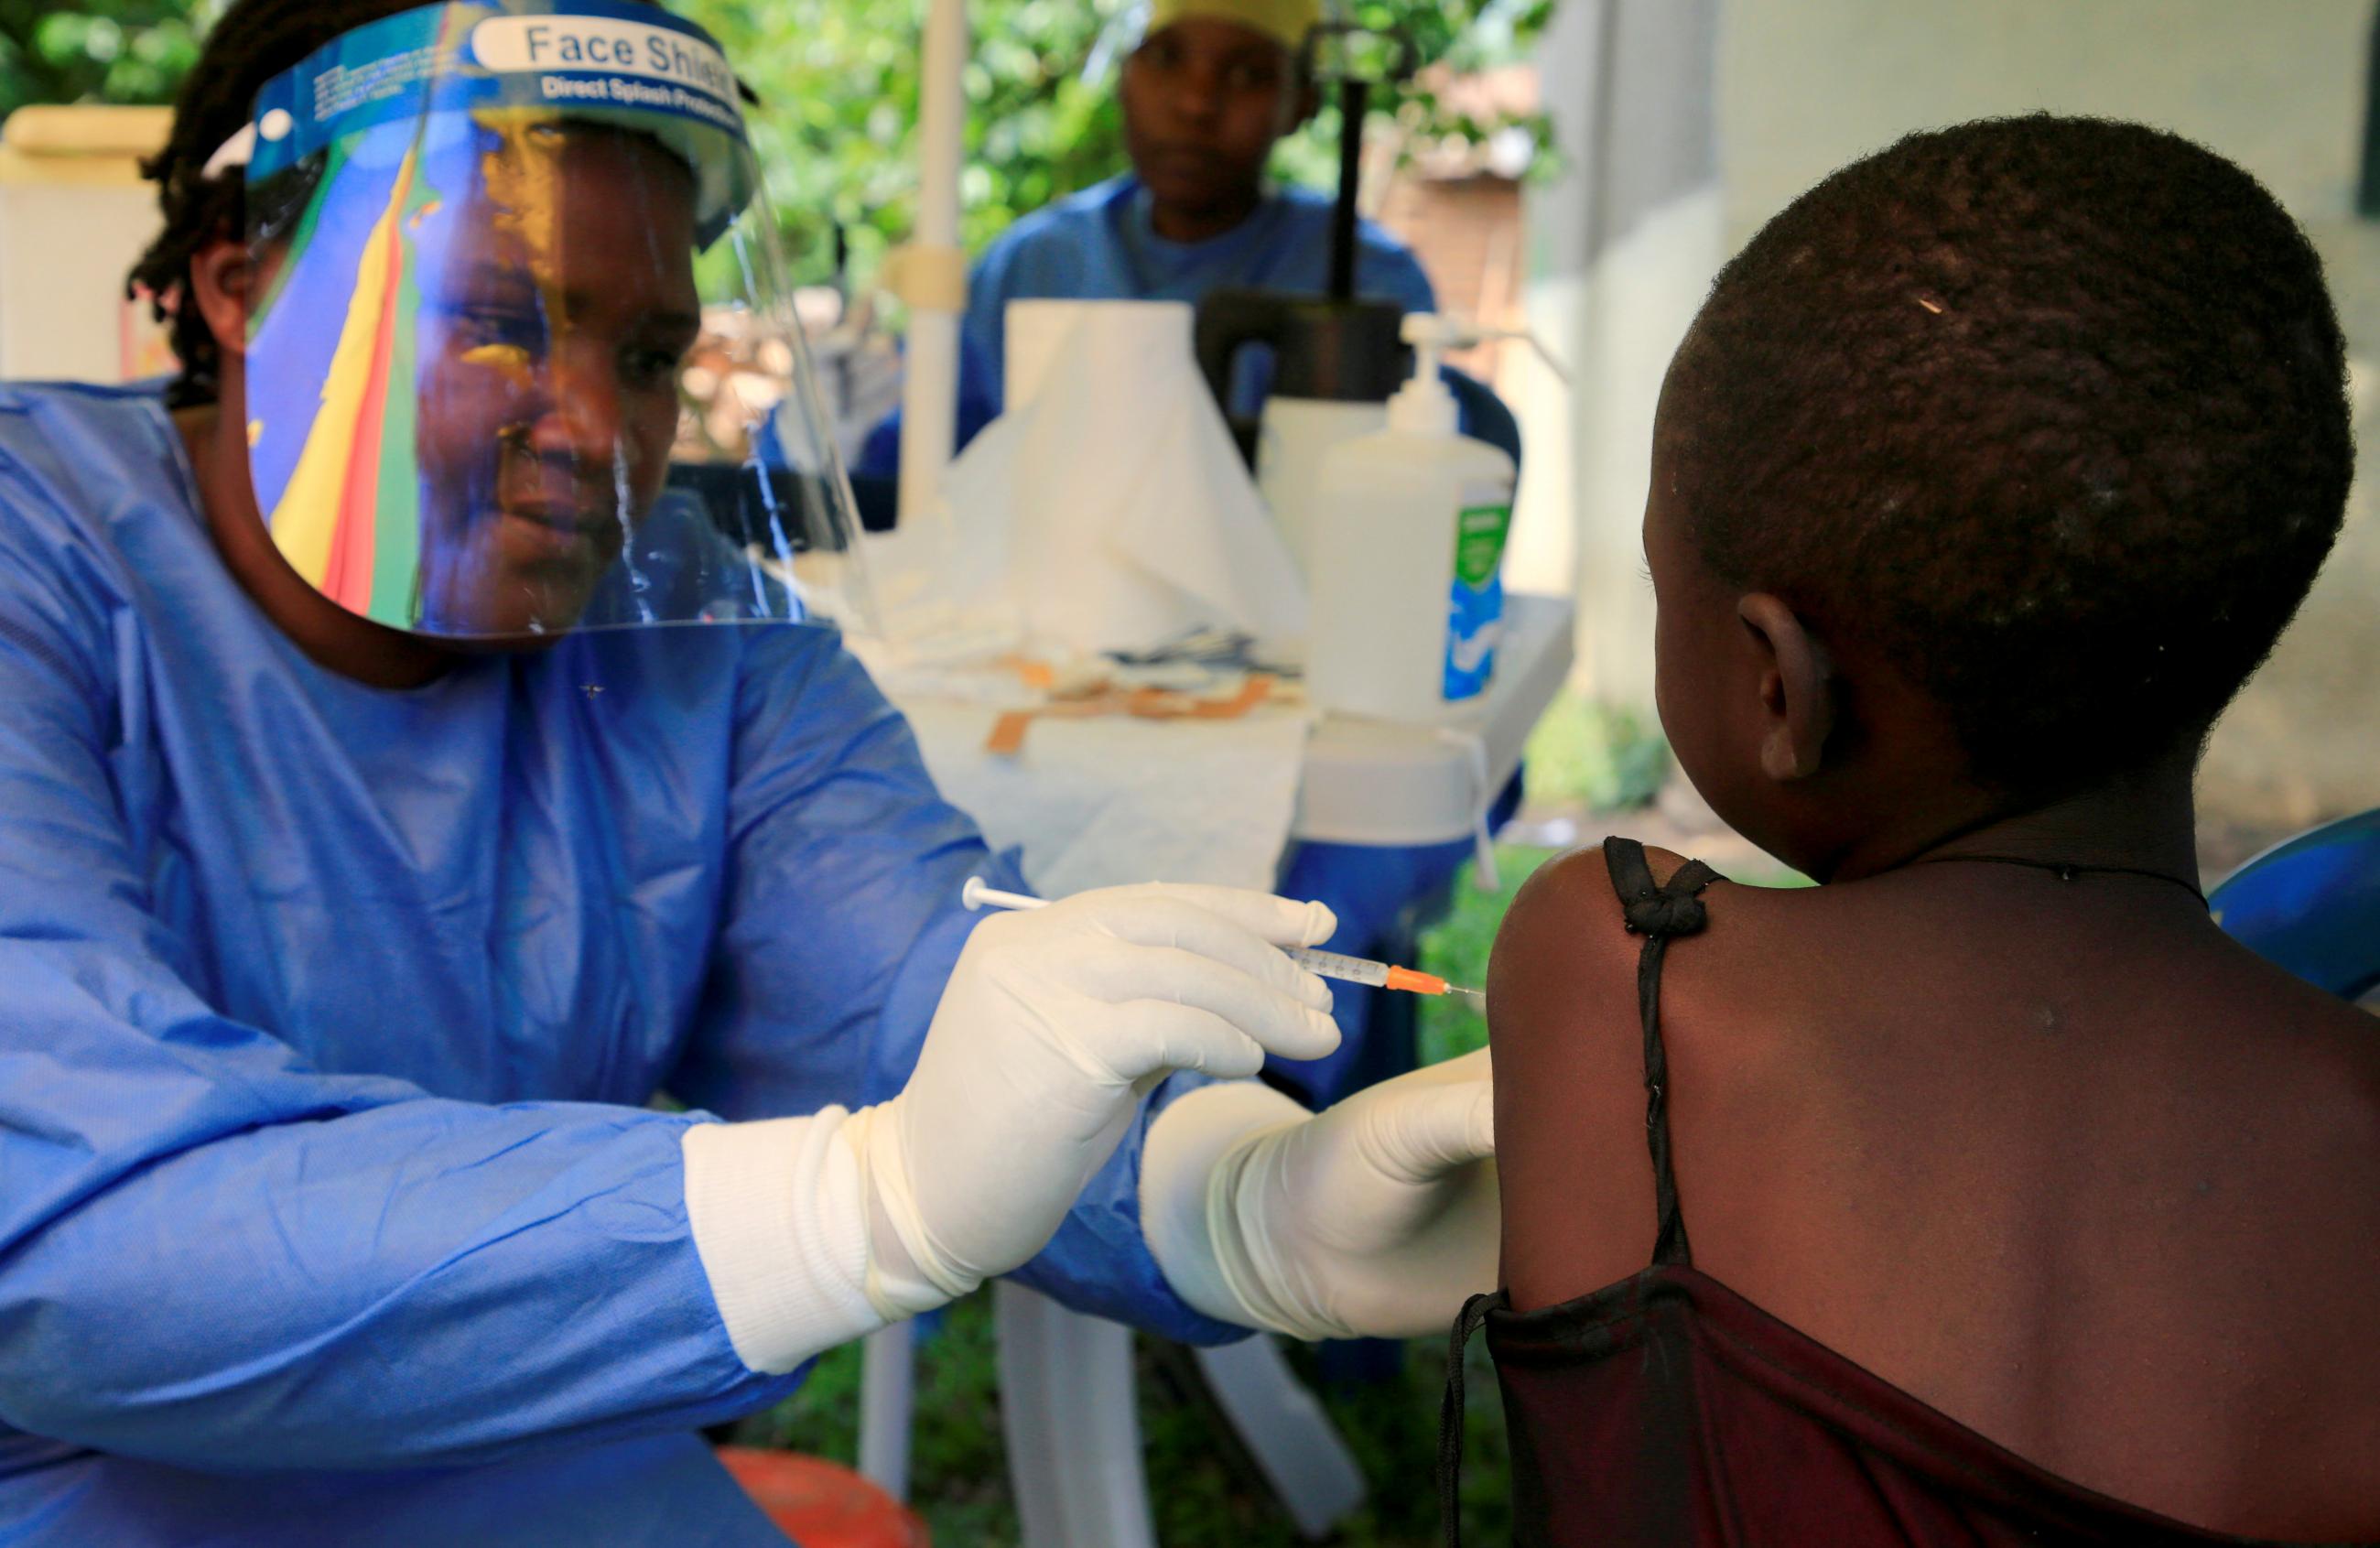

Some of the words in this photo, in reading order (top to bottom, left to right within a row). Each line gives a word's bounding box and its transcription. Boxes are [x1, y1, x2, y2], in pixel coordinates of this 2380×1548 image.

[527, 26, 633, 65] Face
[541, 76, 608, 99] Direct
[609, 79, 671, 105] Splash
